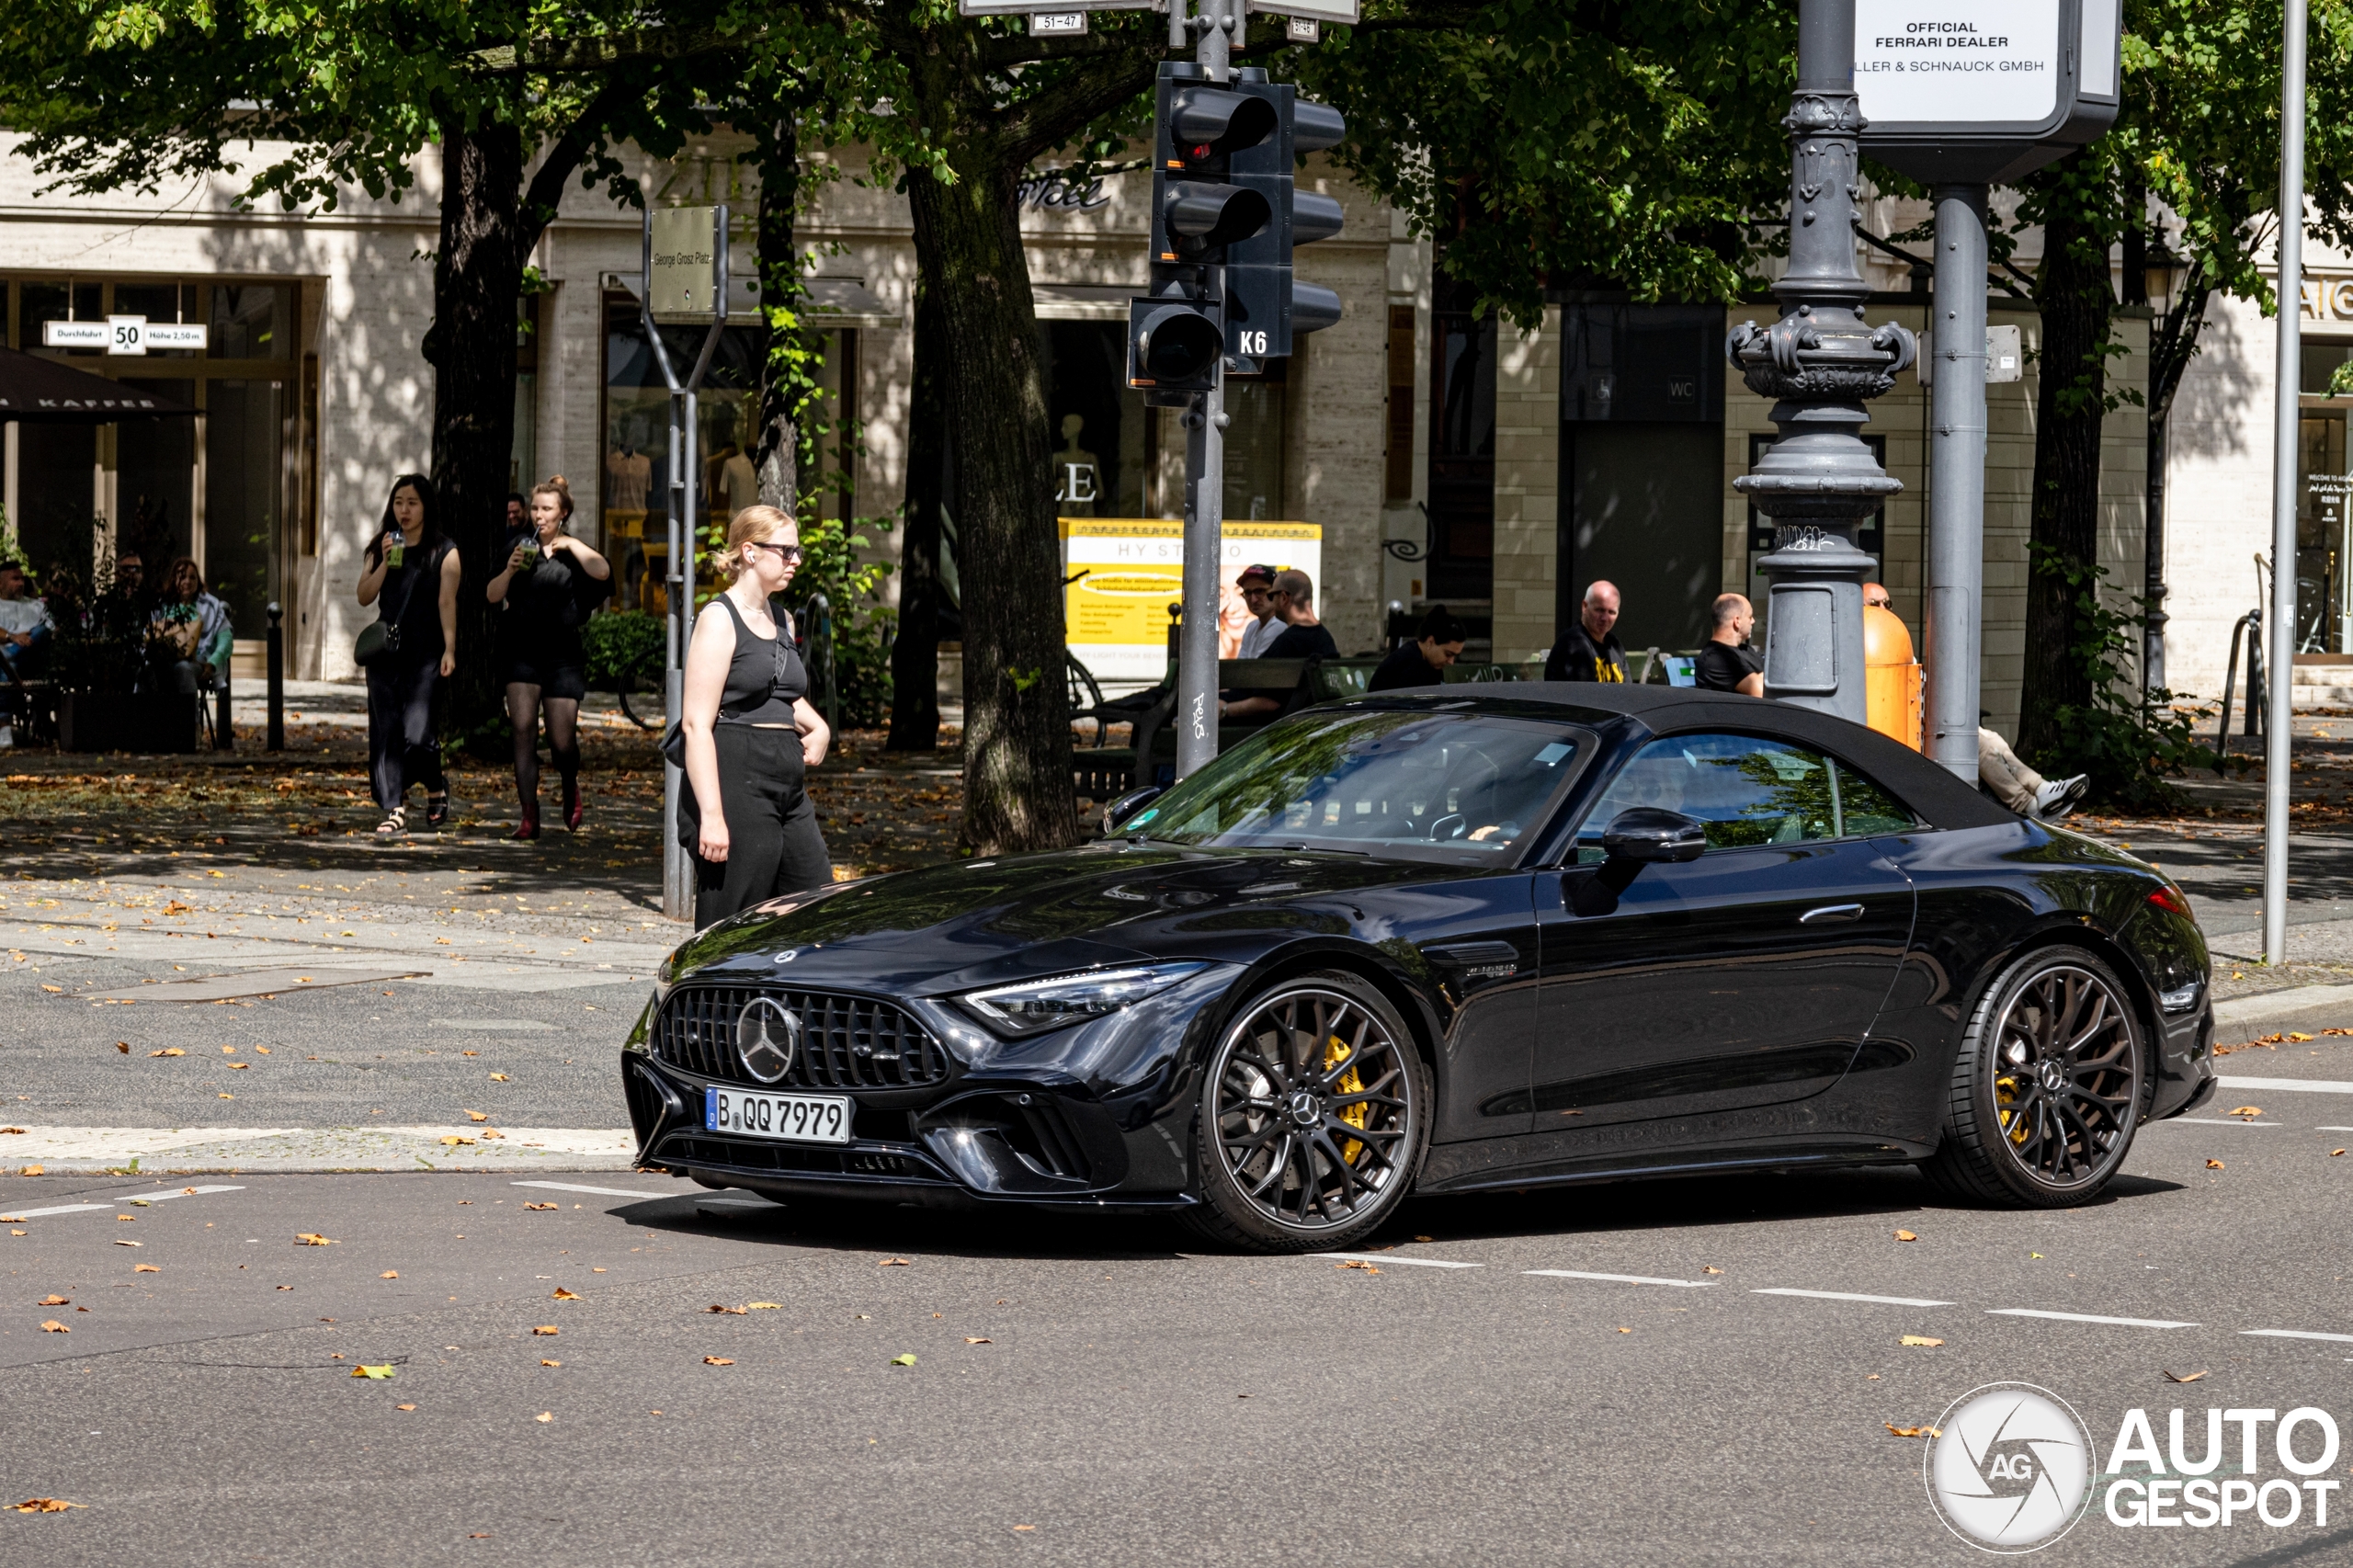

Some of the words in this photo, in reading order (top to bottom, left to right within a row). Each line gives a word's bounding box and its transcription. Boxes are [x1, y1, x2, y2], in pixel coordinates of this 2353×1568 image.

[1044, 16, 1076, 28] 51-47
[1906, 22, 1978, 33] OFFICIAL
[1876, 37, 1942, 48] FERRARI
[1947, 37, 2008, 47] DEALER
[1895, 62, 1905, 72] &
[1910, 61, 1995, 72] SCHNAUCK
[1999, 61, 2044, 72] GMBH
[654, 253, 676, 268] George
[676, 252, 694, 265] Grosz
[696, 252, 710, 265] Platz
[57, 329, 102, 338] Durchfahrt
[116, 326, 139, 344] 50
[150, 332, 171, 340] Höhe
[173, 332, 190, 340] 2,50
[1241, 331, 1267, 354] K6
[1670, 382, 1692, 396] WC
[39, 398, 154, 408] KAFFEE
[1119, 543, 1146, 556] HY
[719, 1094, 730, 1127] B
[744, 1097, 771, 1131] QQ
[778, 1100, 842, 1136] 7979
